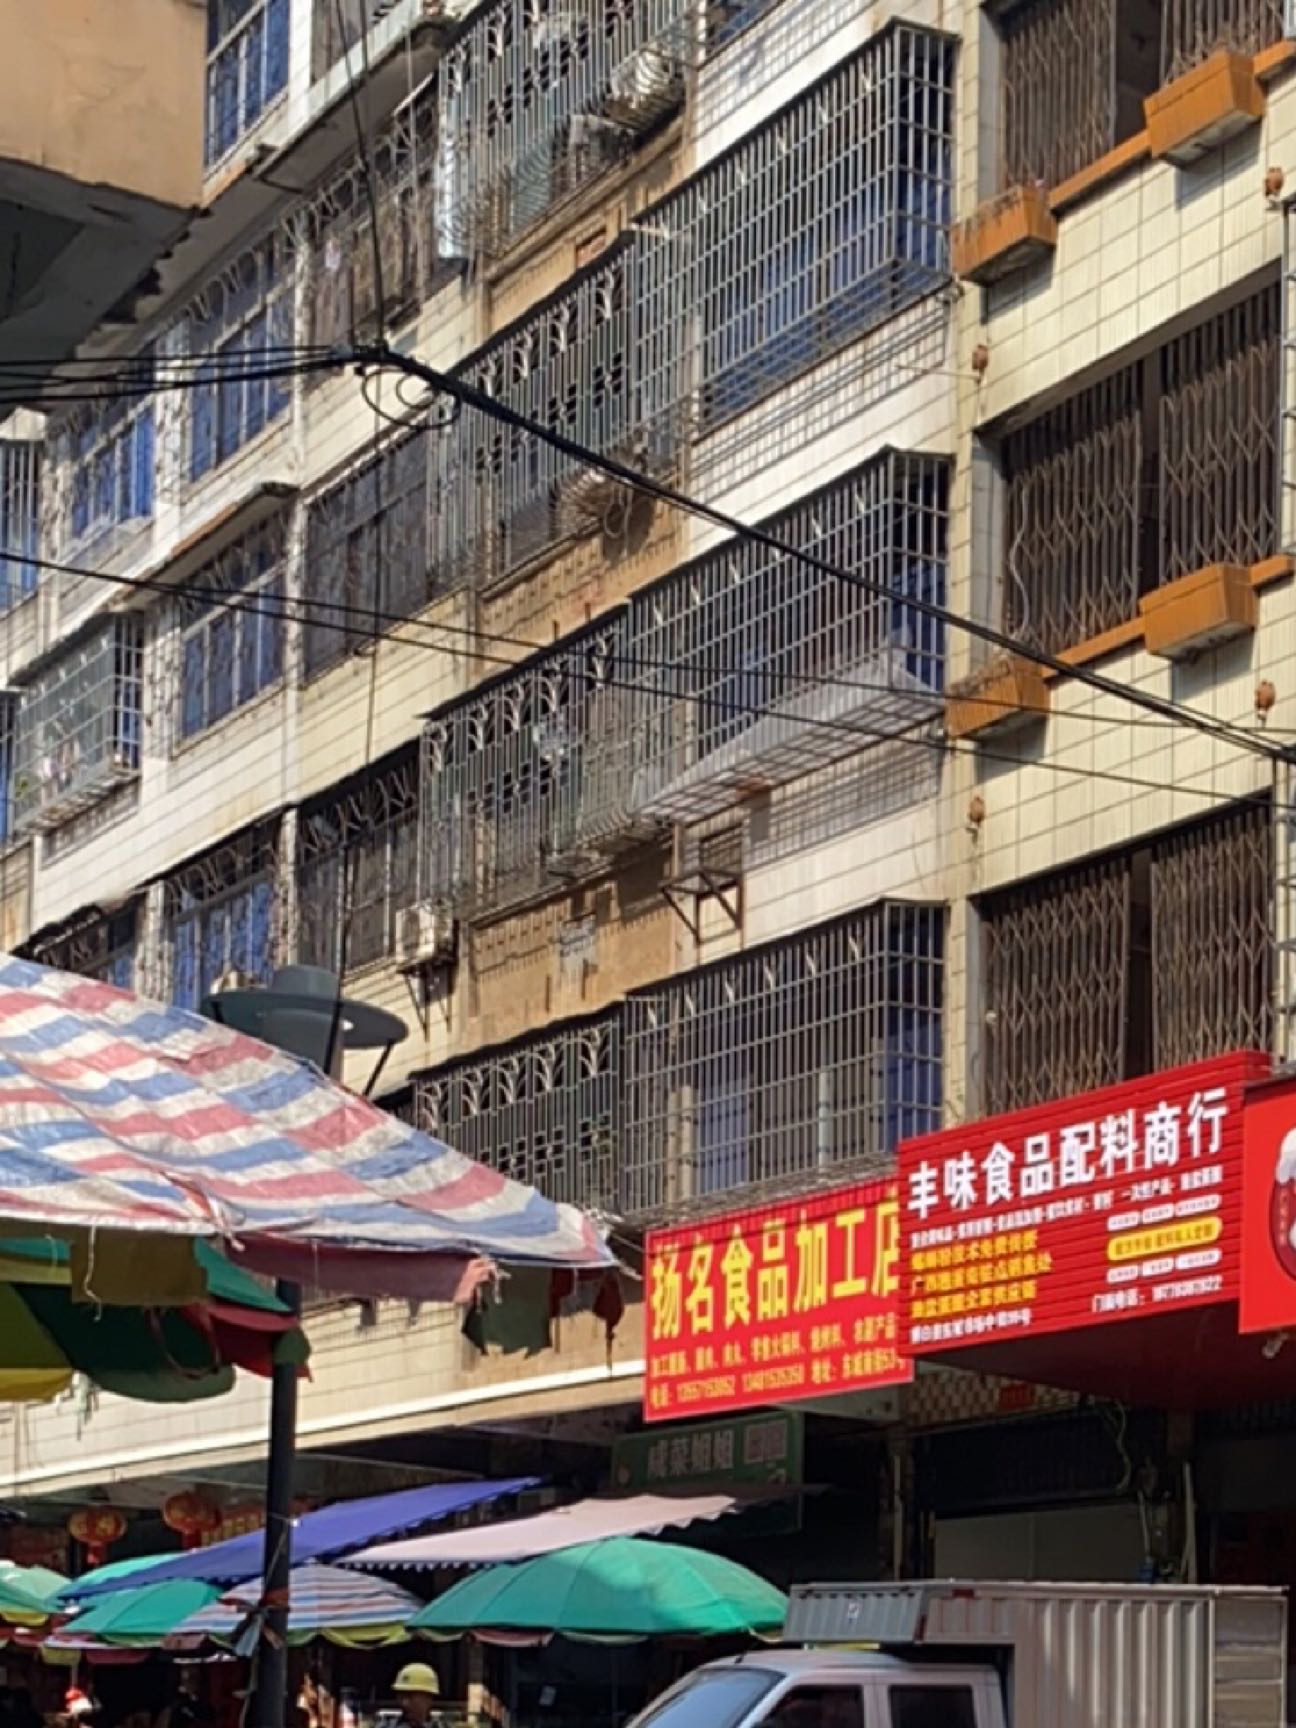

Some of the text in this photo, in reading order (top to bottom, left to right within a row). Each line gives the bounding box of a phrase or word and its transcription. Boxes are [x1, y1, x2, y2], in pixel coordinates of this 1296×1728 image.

[908, 1088, 1226, 1219] 丰味食品配料商行
[652, 1186, 898, 1340] 扬名食品加工店
